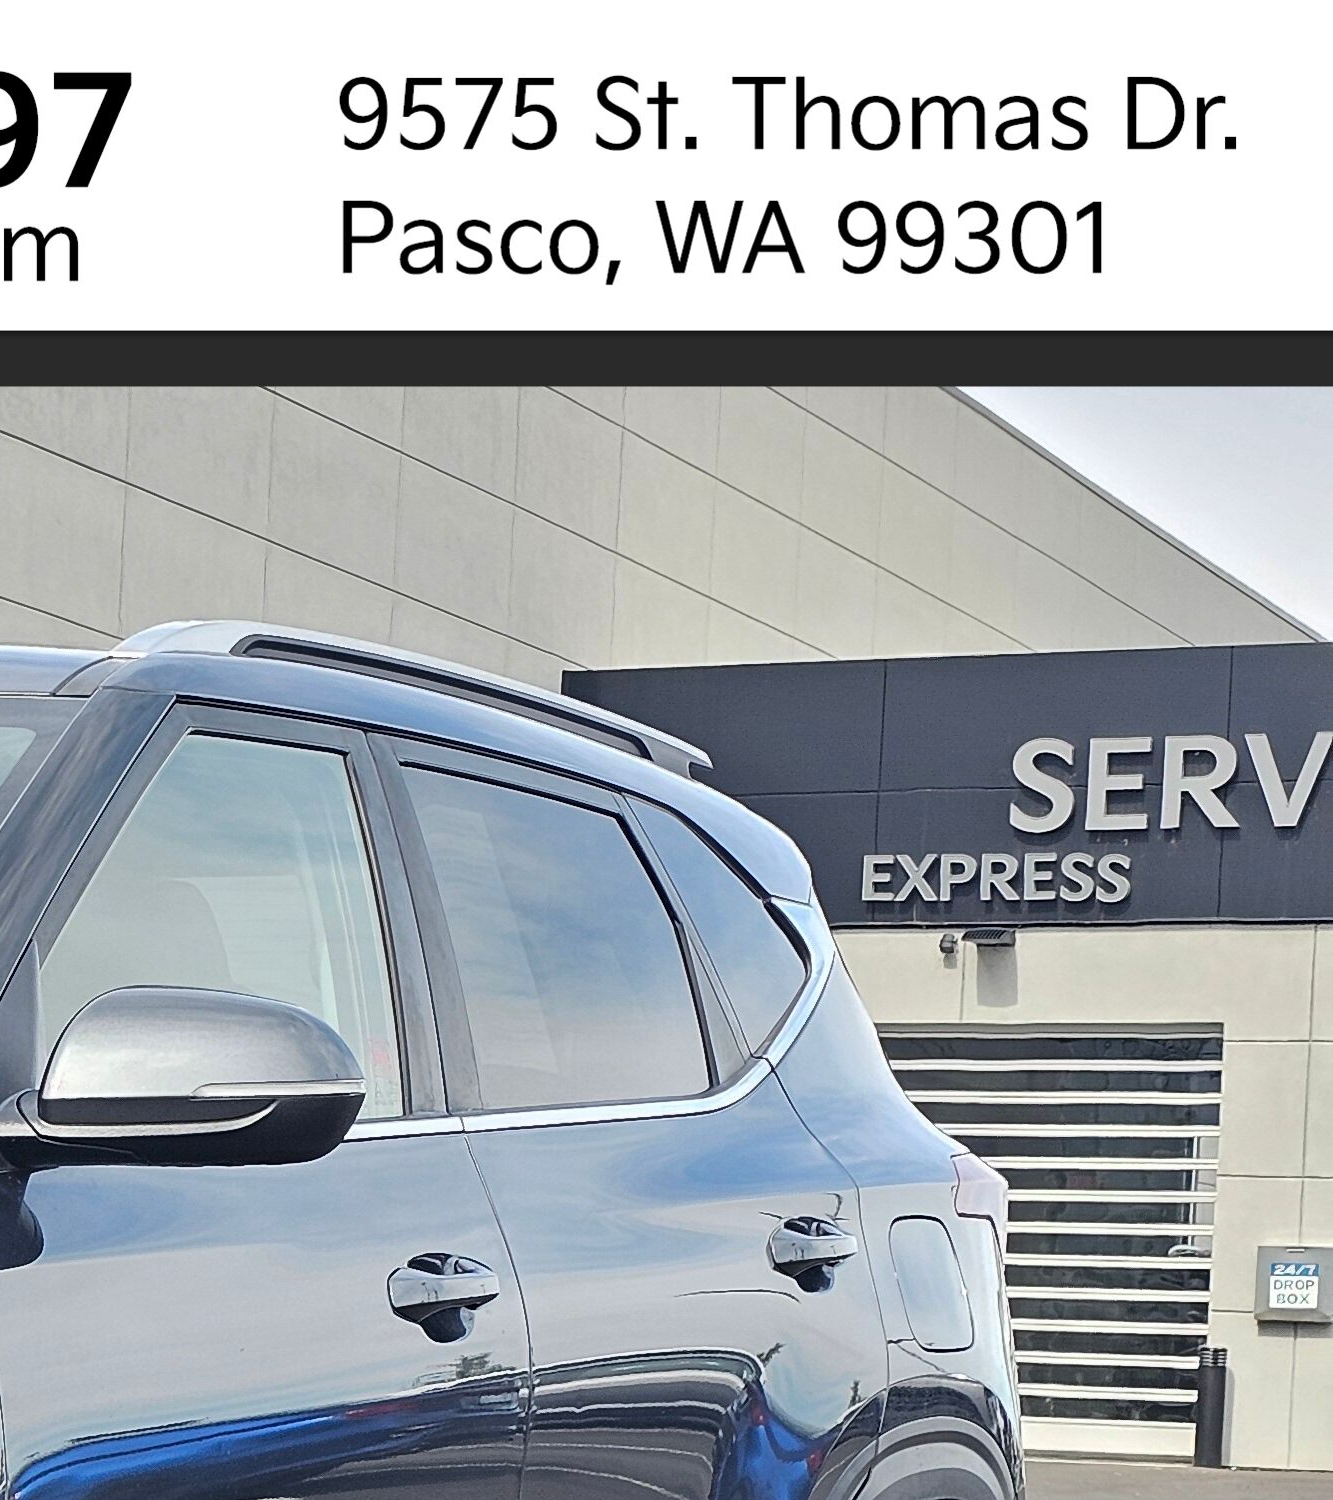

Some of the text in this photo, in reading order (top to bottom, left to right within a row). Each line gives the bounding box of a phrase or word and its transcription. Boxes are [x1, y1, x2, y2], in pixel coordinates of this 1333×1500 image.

[1009, 732, 1333, 834] SERV
[861, 852, 1131, 903] EXPRESS
[1273, 1264, 1316, 1276] 24/7
[1273, 1279, 1315, 1290] DROP
[1276, 1293, 1310, 1304] BOX
